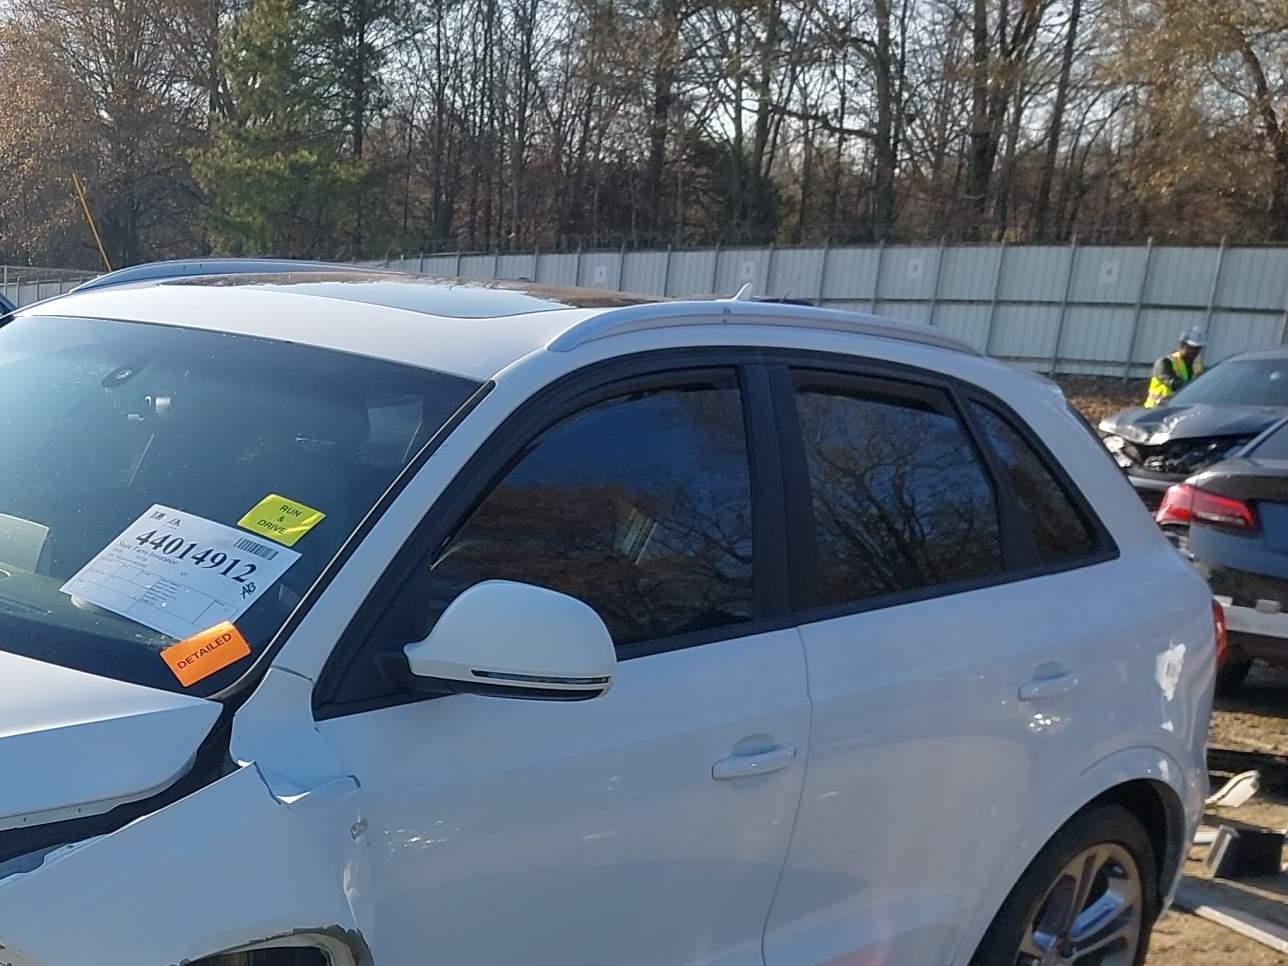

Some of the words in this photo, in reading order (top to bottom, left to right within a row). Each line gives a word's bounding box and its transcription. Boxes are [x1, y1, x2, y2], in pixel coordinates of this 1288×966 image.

[279, 504, 303, 517] RUN
[257, 519, 289, 535] DRIVE
[276, 515, 285, 523] &
[135, 529, 257, 583] 44014912
[176, 633, 232, 669] DETAILED
